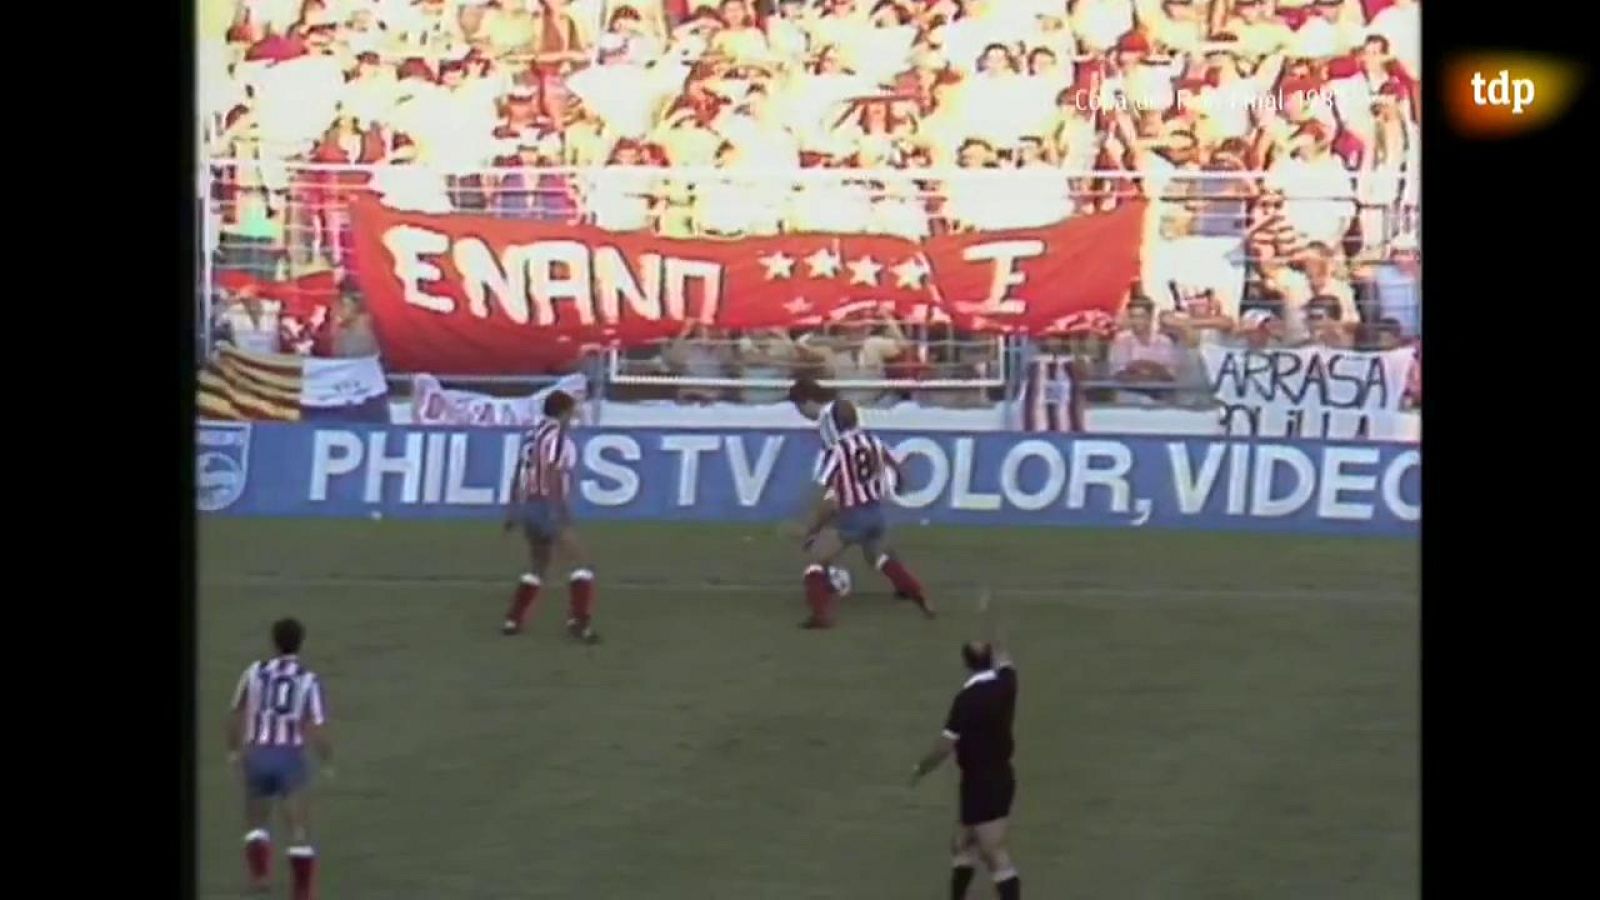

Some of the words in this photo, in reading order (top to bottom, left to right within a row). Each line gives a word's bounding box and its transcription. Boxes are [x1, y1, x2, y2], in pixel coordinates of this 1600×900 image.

[1211, 351, 1388, 409] ARRASA
[309, 428, 642, 506] PHILIS
[660, 434, 786, 508] TV
[888, 436, 1152, 526] OLOR,
[260, 676, 295, 714] 10
